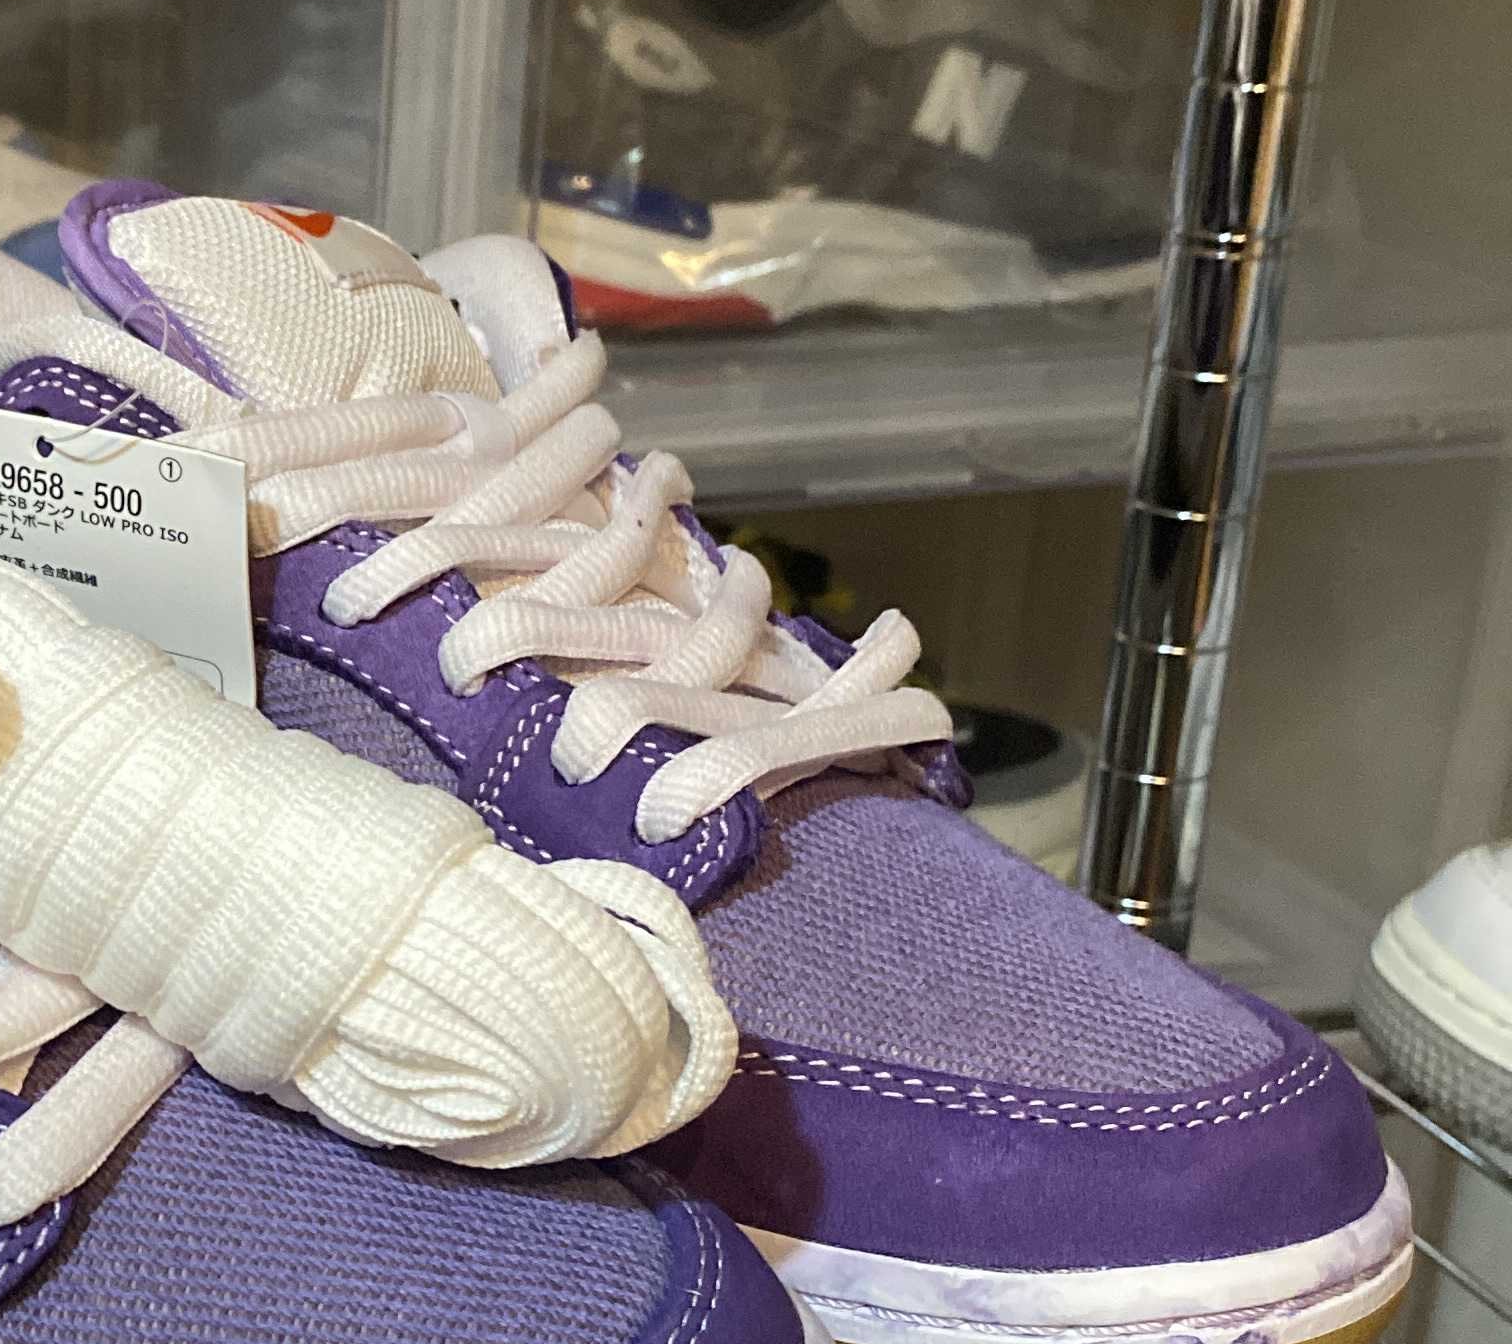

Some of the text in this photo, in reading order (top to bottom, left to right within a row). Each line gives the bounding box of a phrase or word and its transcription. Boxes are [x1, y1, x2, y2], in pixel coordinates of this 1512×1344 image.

[911, 47, 1027, 159] N
[94, 482, 143, 516] 500
[33, 500, 74, 520] ダンク
[81, 510, 116, 529] LOW
[122, 519, 154, 537] PRO
[160, 527, 189, 545] ISO
